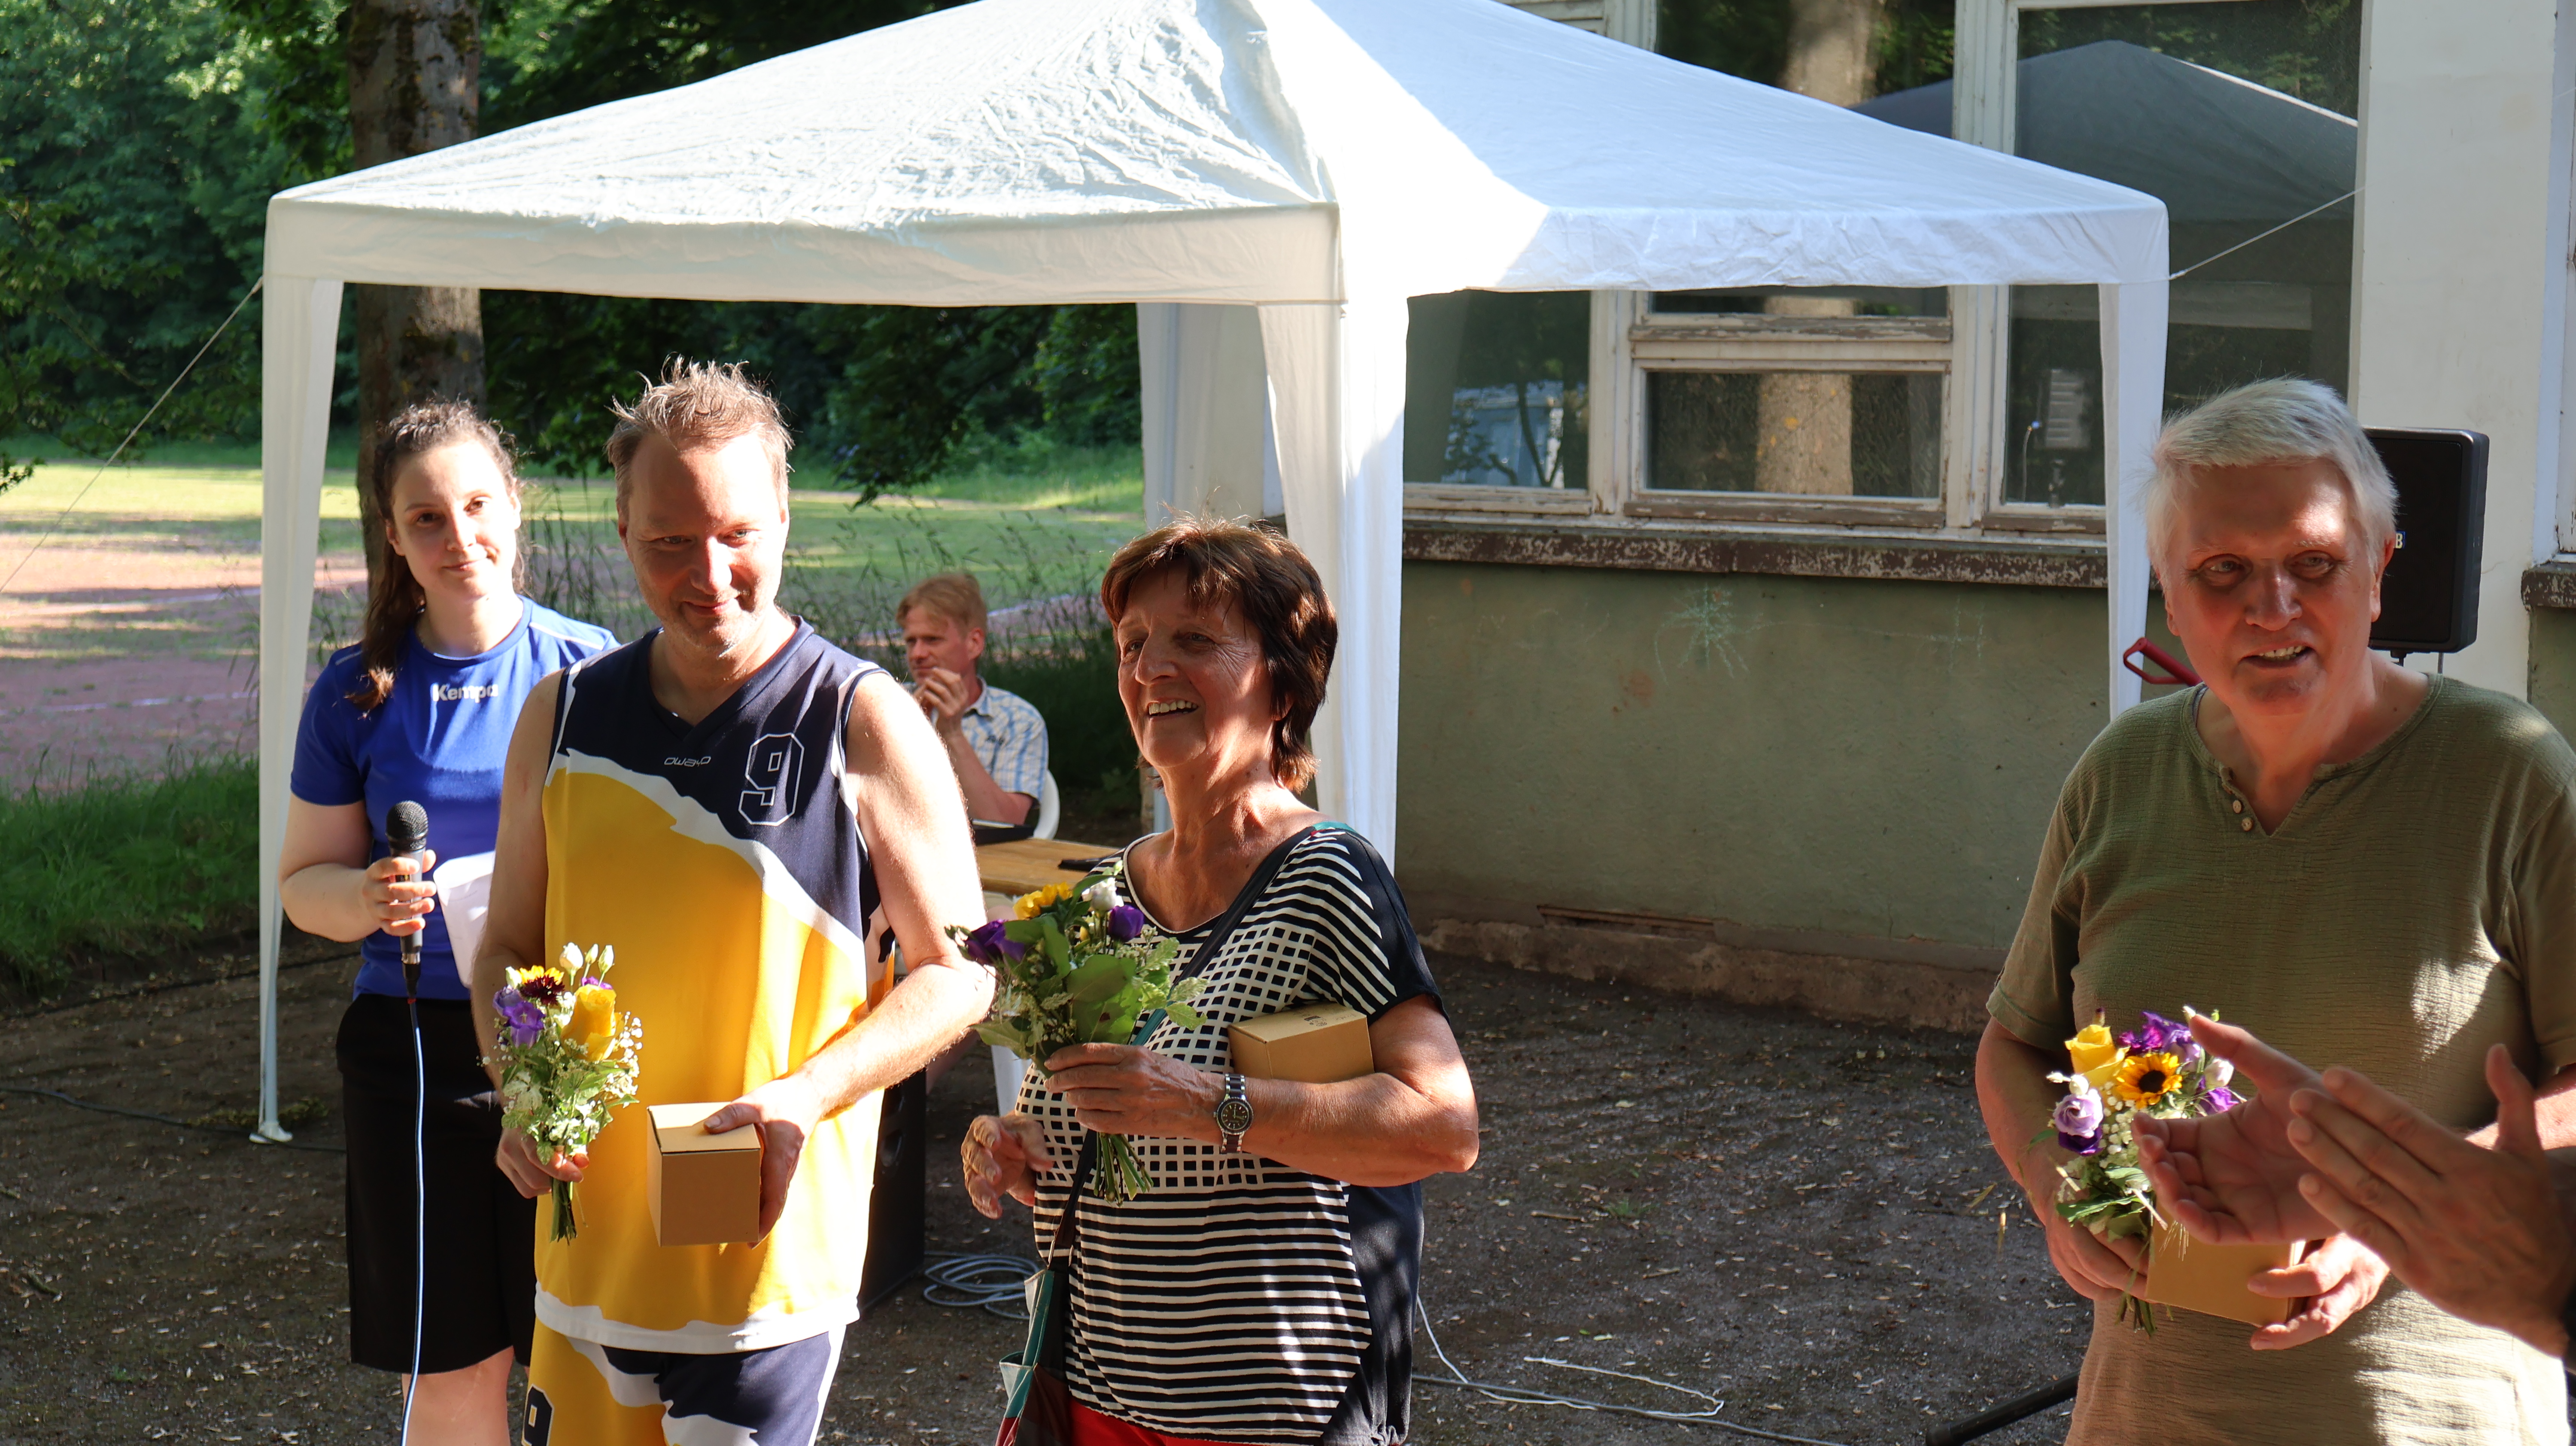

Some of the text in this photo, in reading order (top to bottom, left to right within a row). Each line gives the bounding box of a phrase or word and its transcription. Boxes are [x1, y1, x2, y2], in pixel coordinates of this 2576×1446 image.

[431, 683, 498, 703] Kempa
[664, 756, 711, 767] owayo
[738, 732, 805, 826] 9
[521, 1383, 555, 1446] 9
